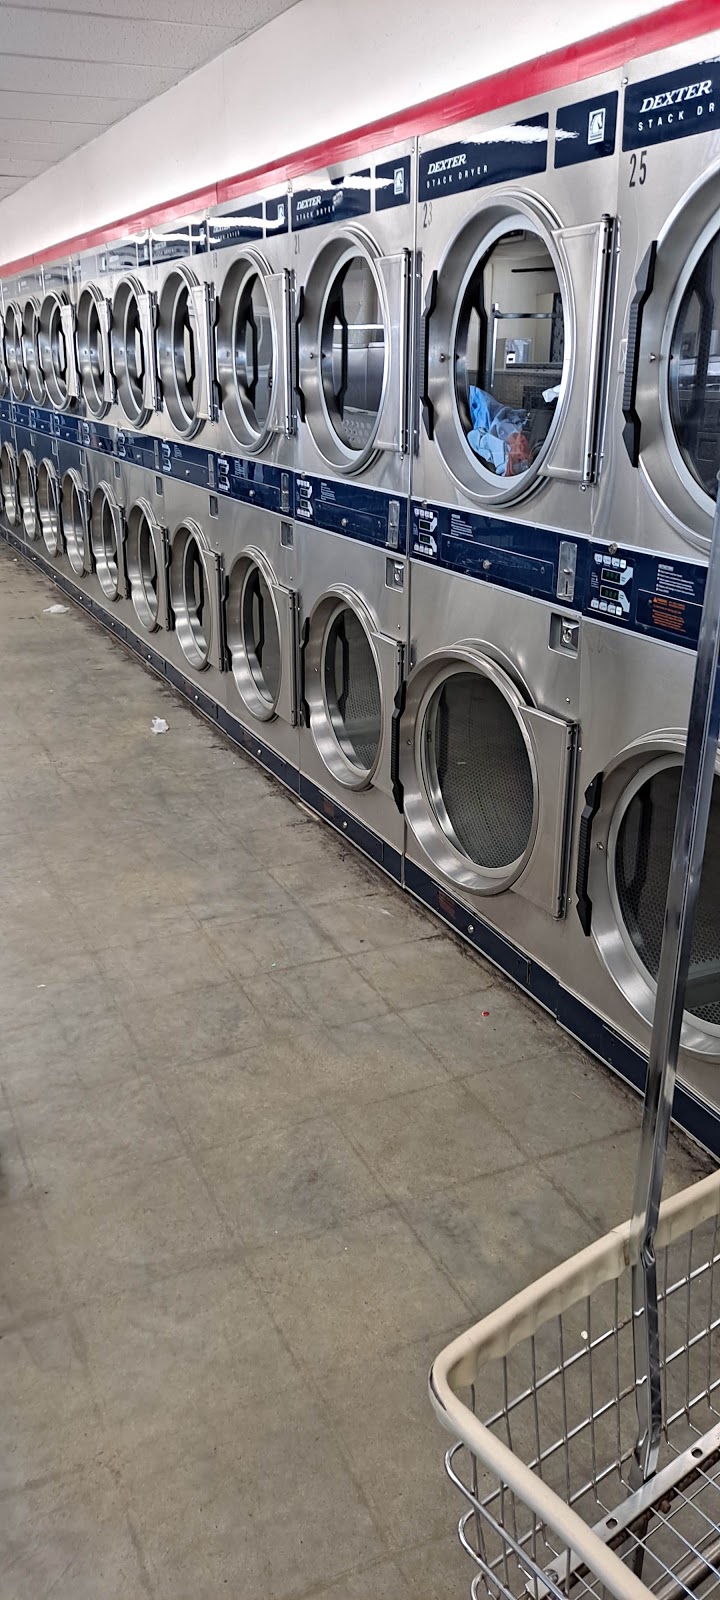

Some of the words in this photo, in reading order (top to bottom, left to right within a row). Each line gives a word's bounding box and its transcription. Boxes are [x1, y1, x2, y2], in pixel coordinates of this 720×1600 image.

[639, 79, 712, 113] DEXTER
[637, 110, 684, 132] STACK
[426, 174, 453, 189] STACK
[458, 164, 488, 181] DRYER
[427, 153, 467, 175] DEXTER
[629, 150, 647, 188] 25
[296, 195, 322, 211] DEXTER
[422, 201, 433, 229] 23
